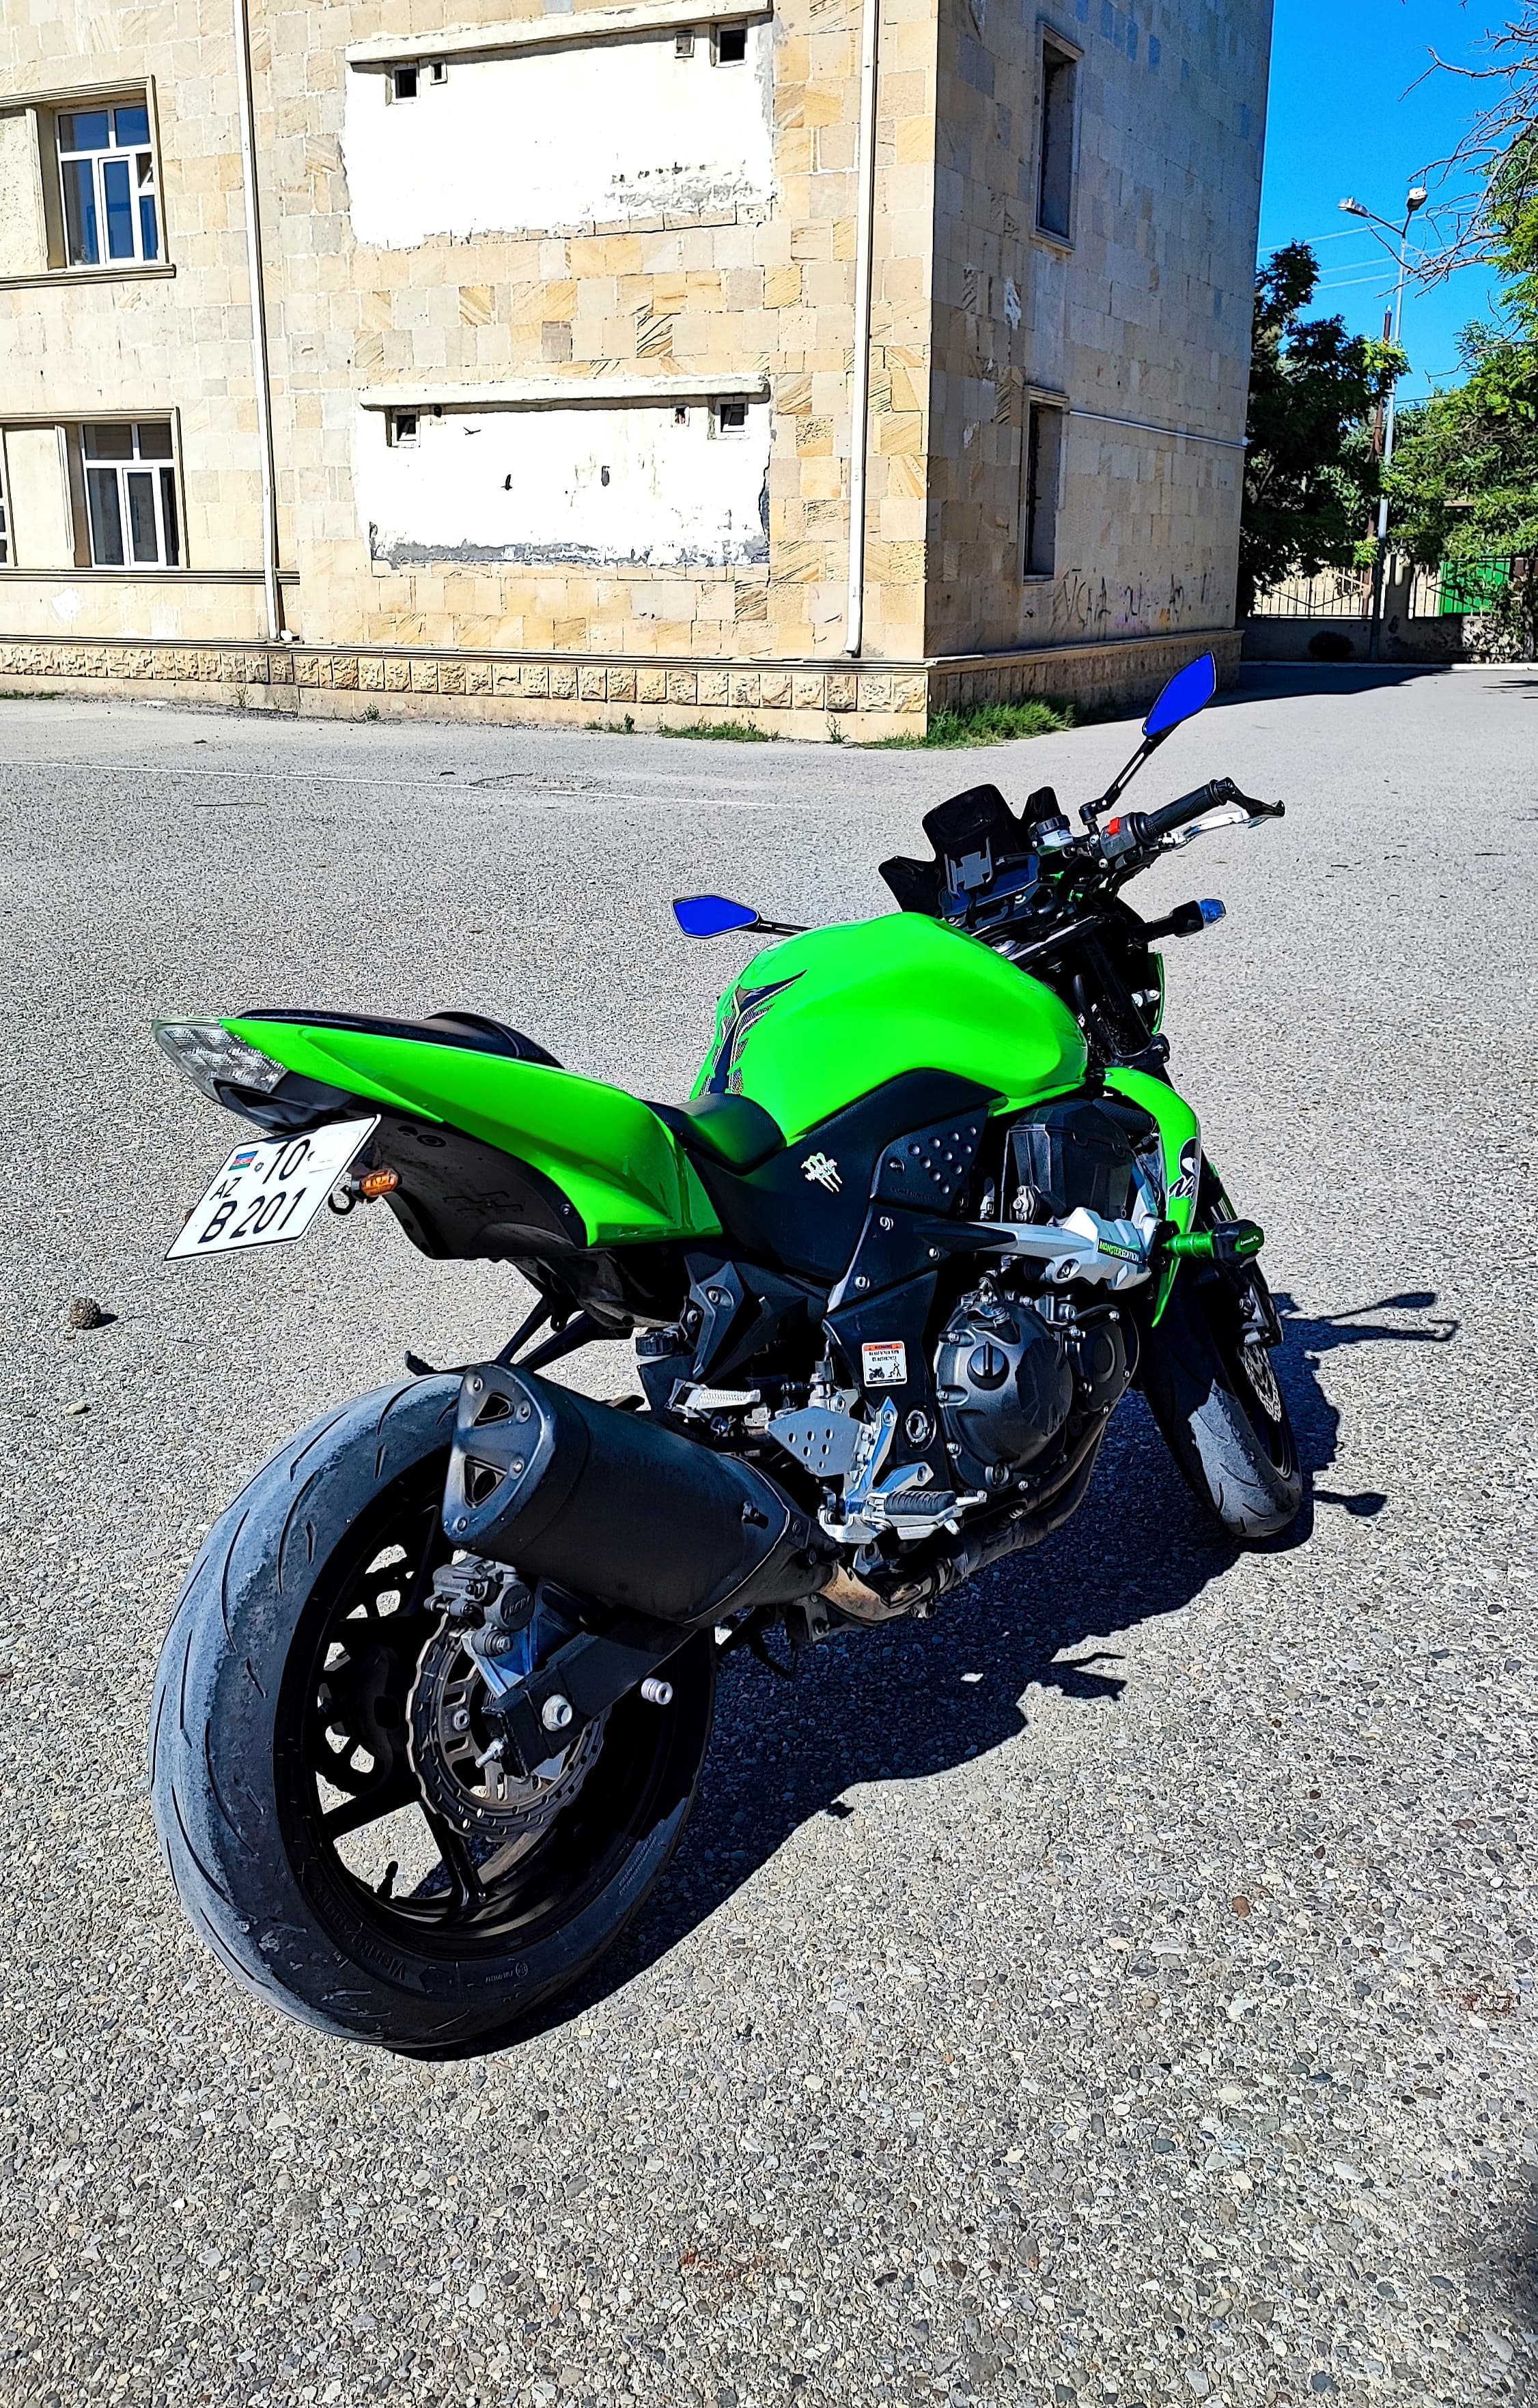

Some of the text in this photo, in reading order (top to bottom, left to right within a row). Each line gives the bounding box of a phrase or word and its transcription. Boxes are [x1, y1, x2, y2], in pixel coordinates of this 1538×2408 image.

[209, 1176, 242, 1201] AZ
[197, 1187, 307, 1244] B 201
